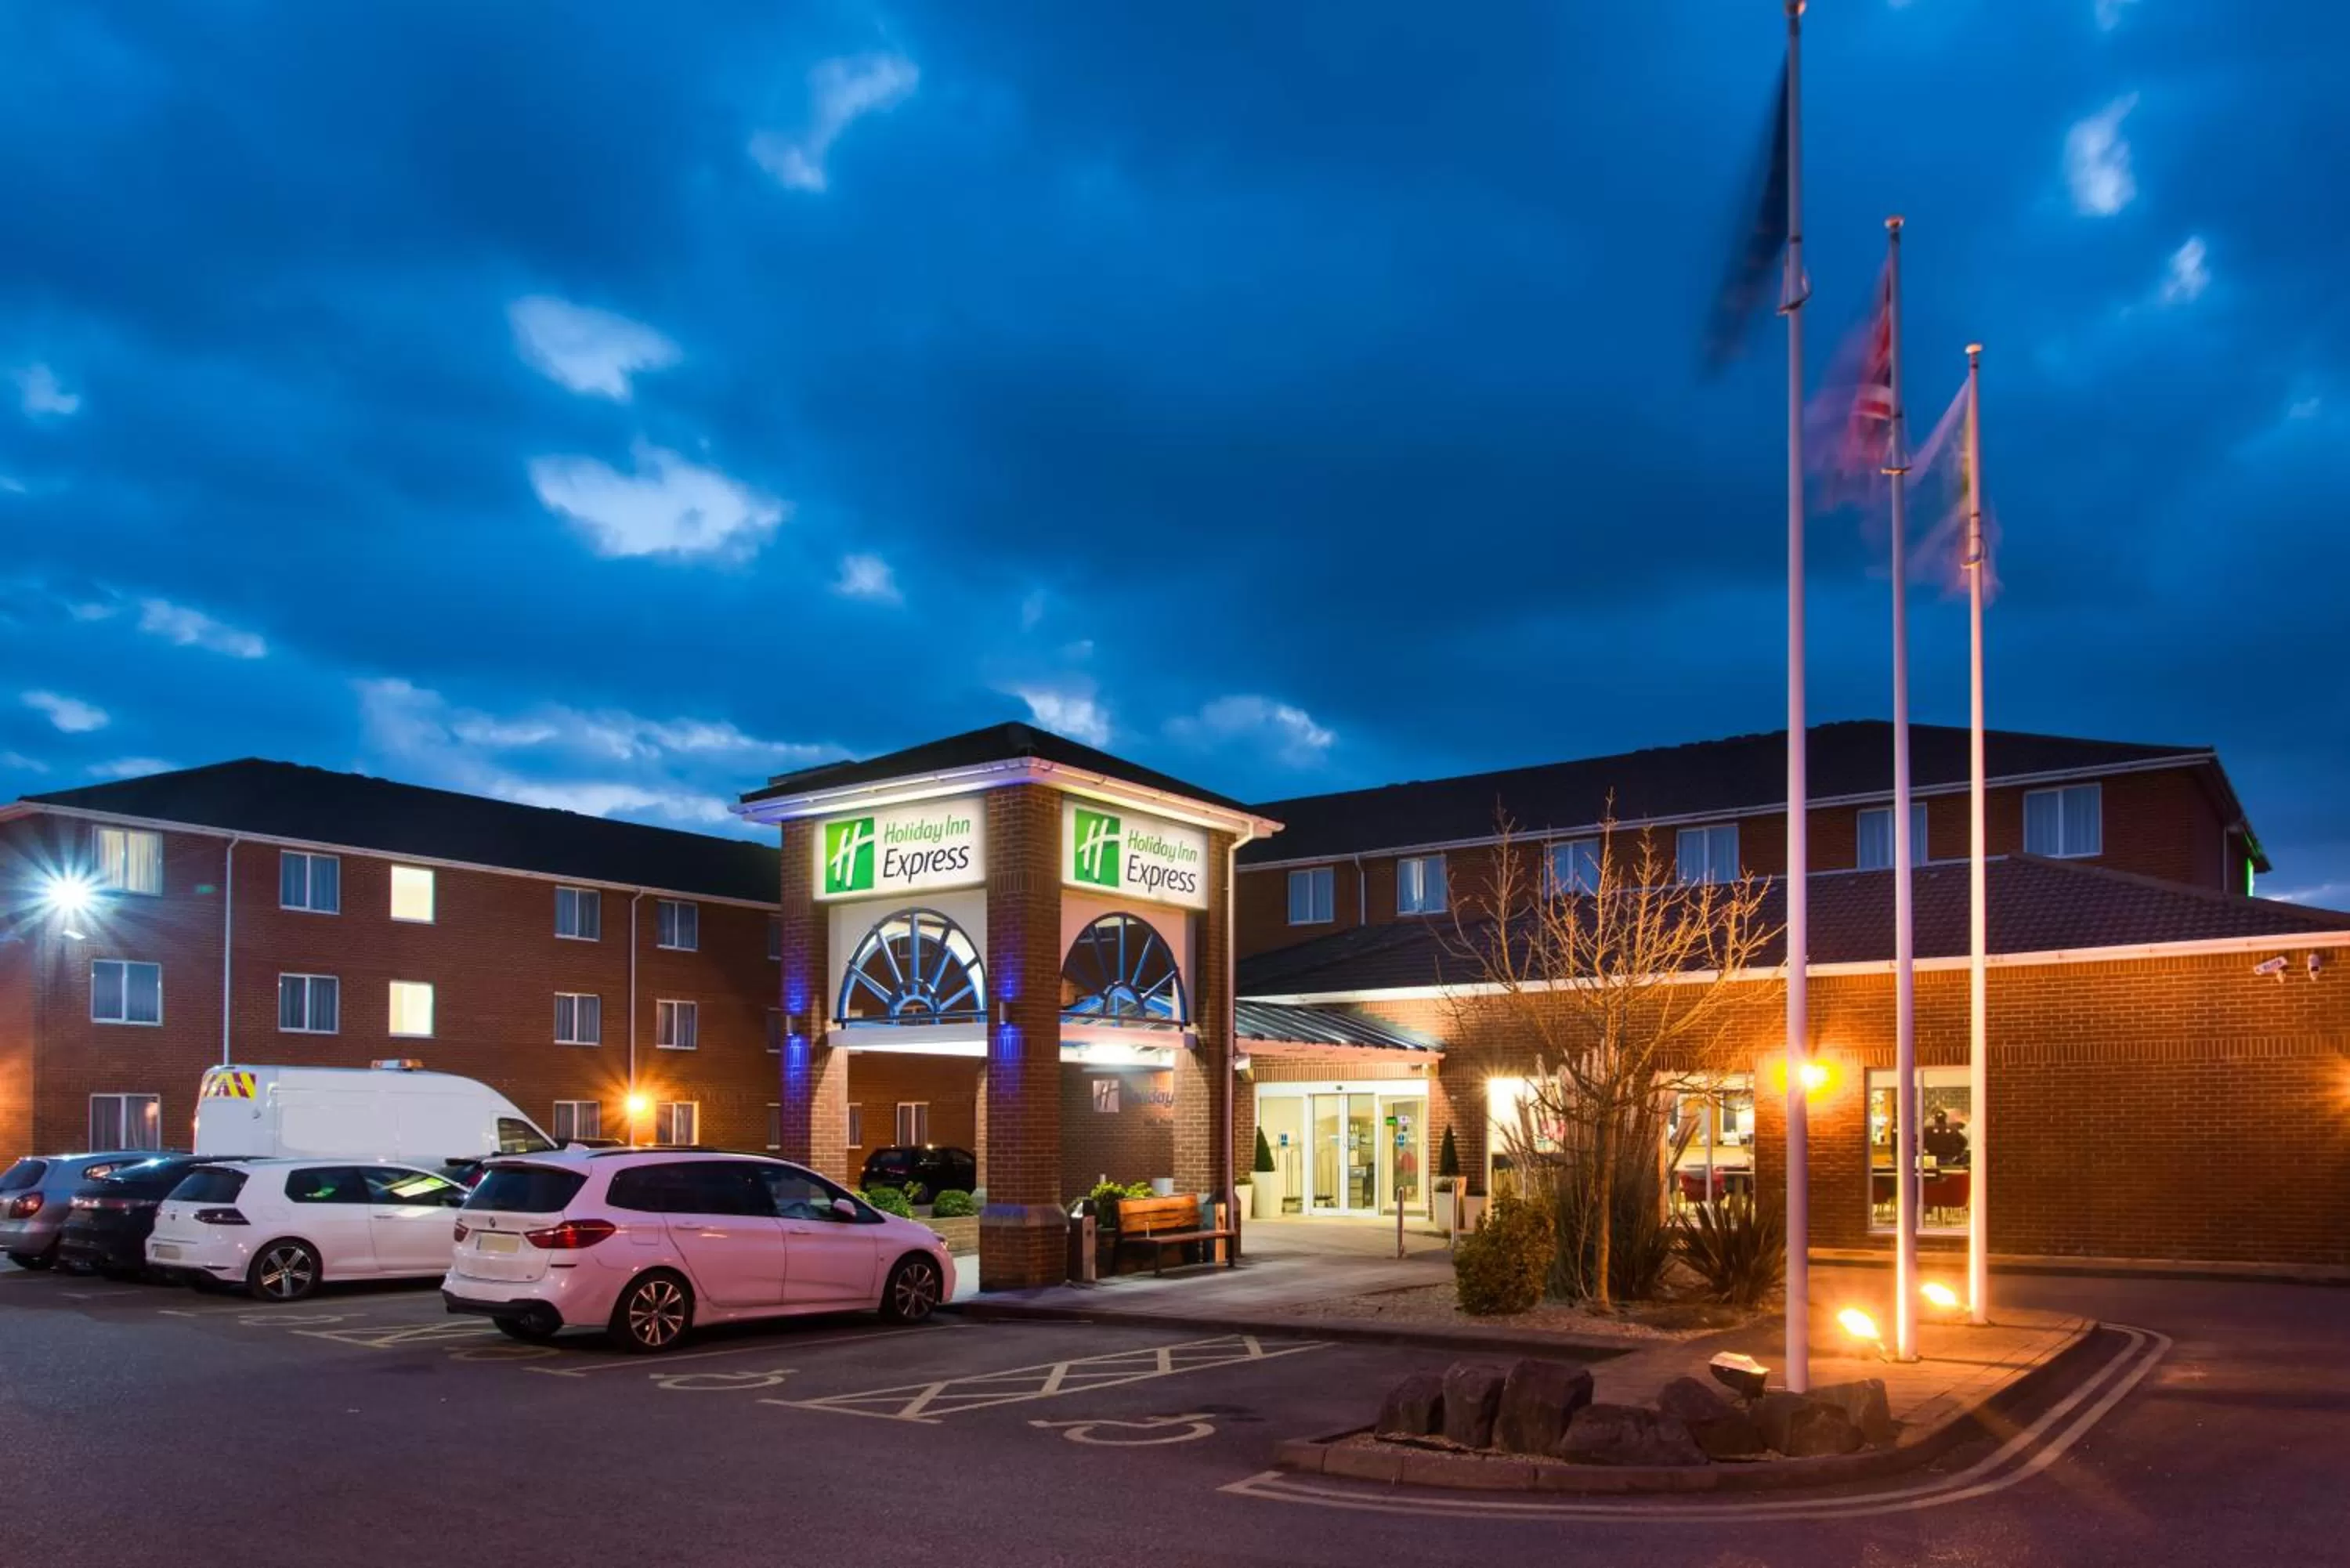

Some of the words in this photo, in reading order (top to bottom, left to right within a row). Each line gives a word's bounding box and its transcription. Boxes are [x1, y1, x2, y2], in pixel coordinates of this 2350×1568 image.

[884, 818, 943, 844] Holiday
[945, 815, 971, 836] Inn
[1128, 829, 1175, 862] Holiday
[1177, 840, 1198, 862] Inn
[883, 845, 970, 883] Express
[1127, 854, 1197, 893] Express
